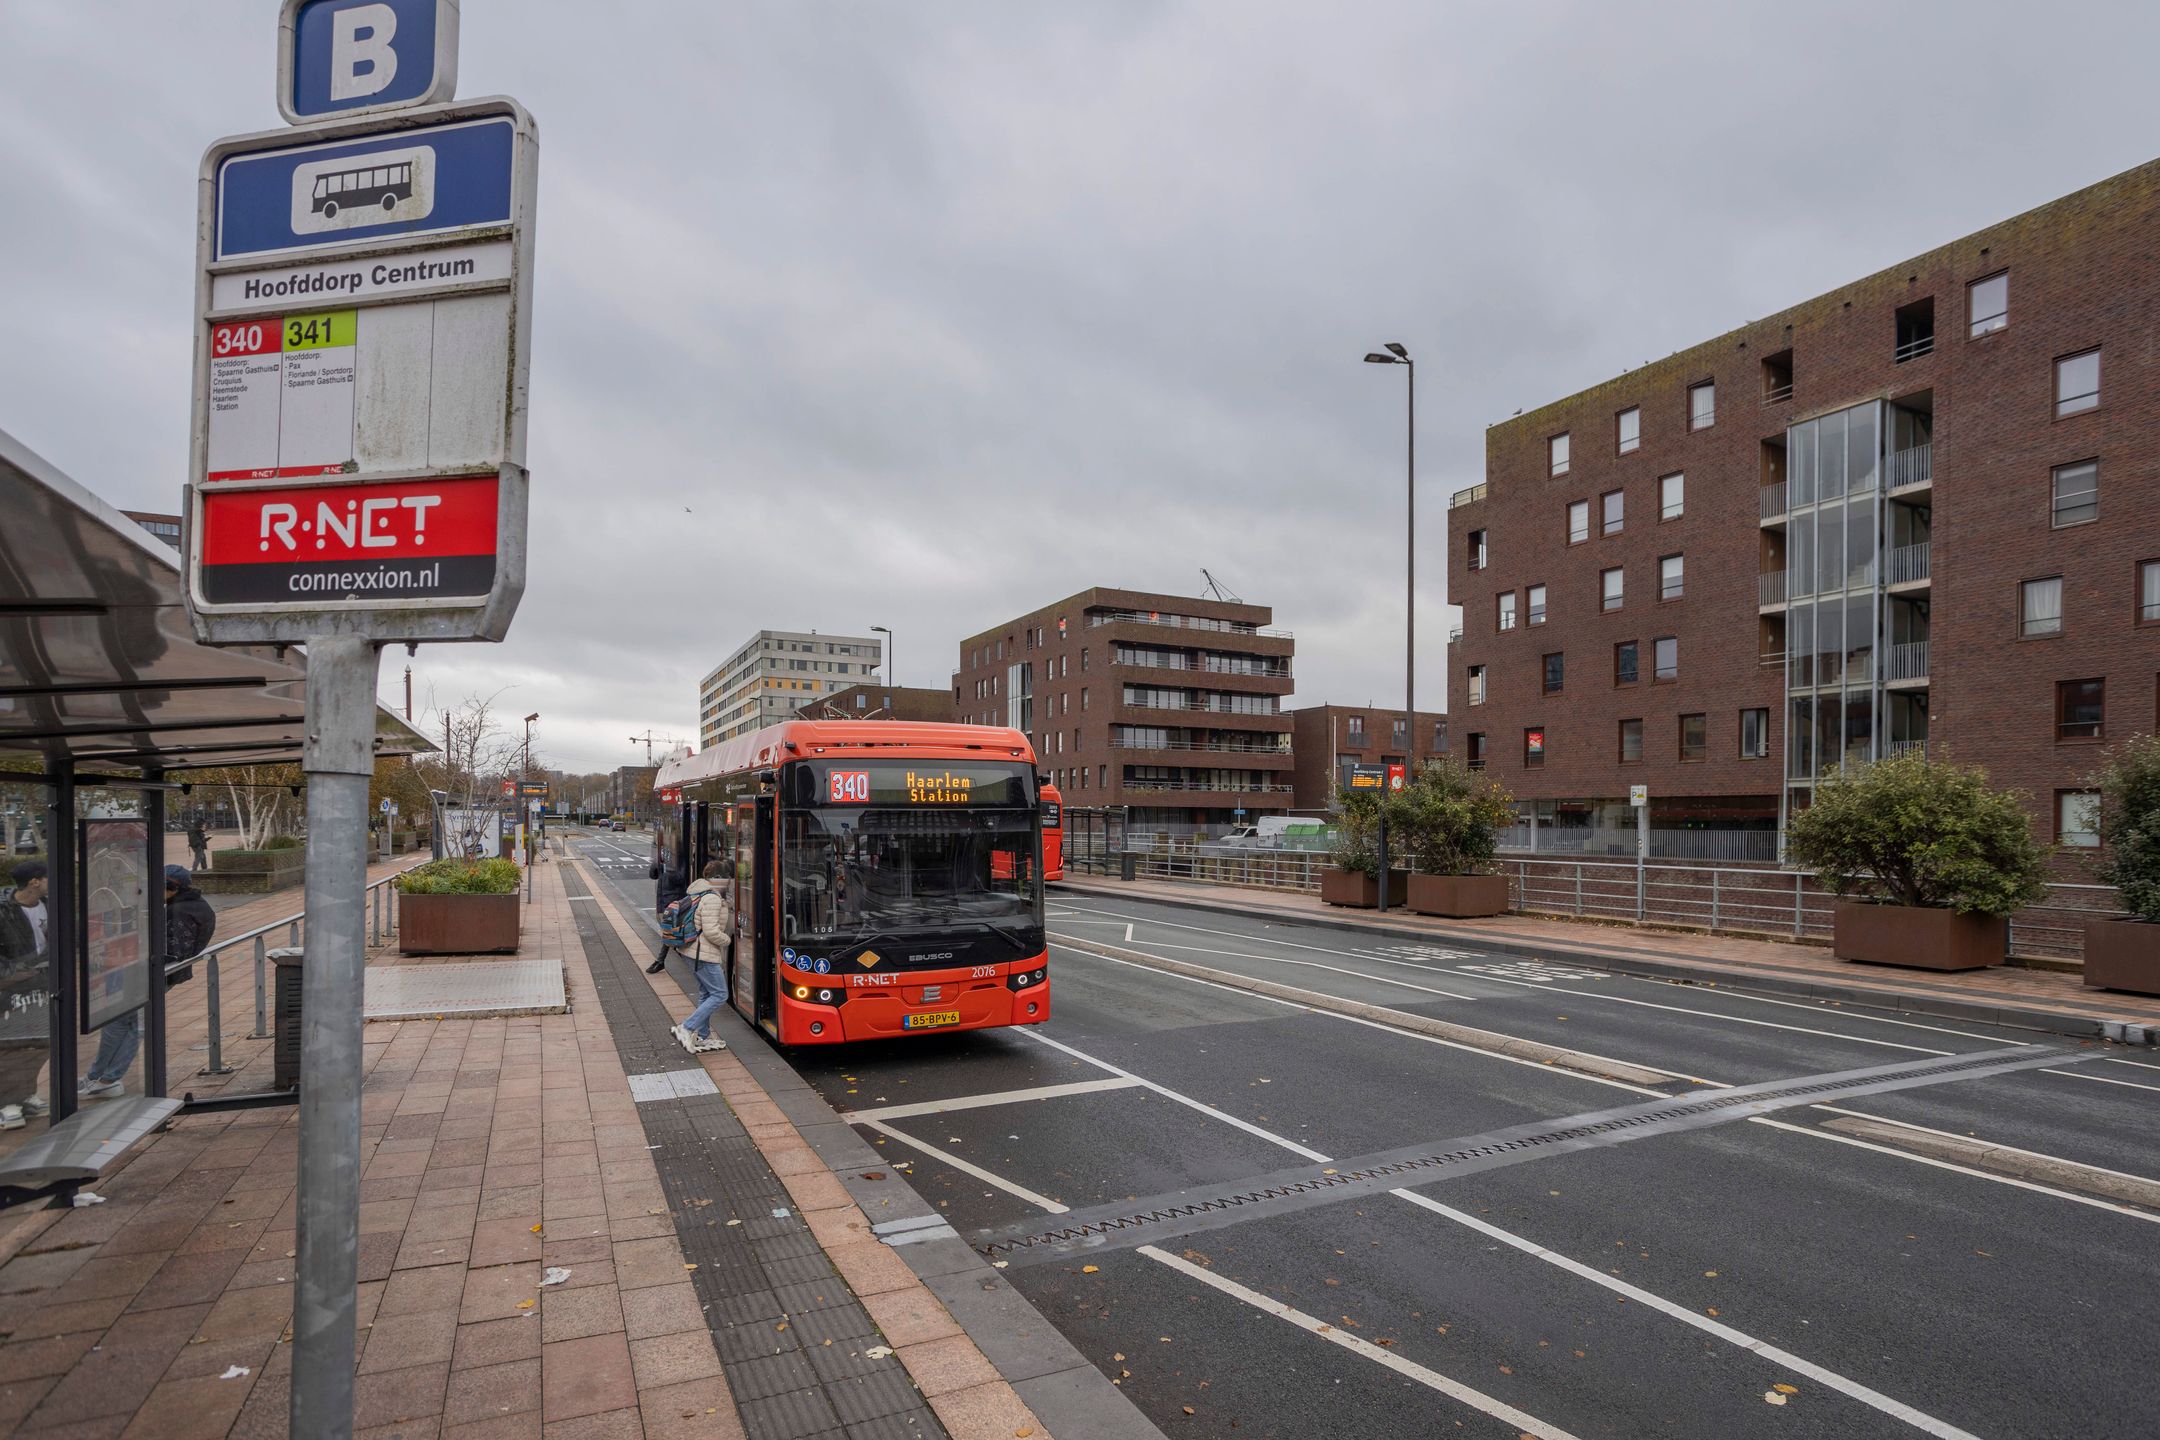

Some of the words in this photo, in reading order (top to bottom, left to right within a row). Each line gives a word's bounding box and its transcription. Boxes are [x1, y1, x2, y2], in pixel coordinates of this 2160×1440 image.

[331, 3, 397, 101] B
[245, 272, 363, 299] Hoofddorp
[371, 258, 474, 285] Centrum
[288, 318, 331, 347] 341
[216, 325, 262, 354] 340
[285, 353, 322, 361] Hoofddorp:
[218, 369, 244, 377] Spaarne
[245, 366, 274, 374] Gasthuis
[321, 367, 353, 376] Sportdorp
[213, 378, 242, 386] Cruquius
[288, 379, 316, 388] Spaarne
[316, 376, 347, 385] Gasthuis
[213, 385, 248, 394] Heemstede
[216, 403, 239, 411] Station
[289, 562, 440, 591] connexxion.nl
[832, 773, 868, 800] 340
[906, 771, 970, 788] Haarlem
[910, 788, 968, 802] Station
[909, 952, 953, 962] EBUSCO
[972, 966, 996, 978] 2076
[1456, 962, 1611, 982] BUS
